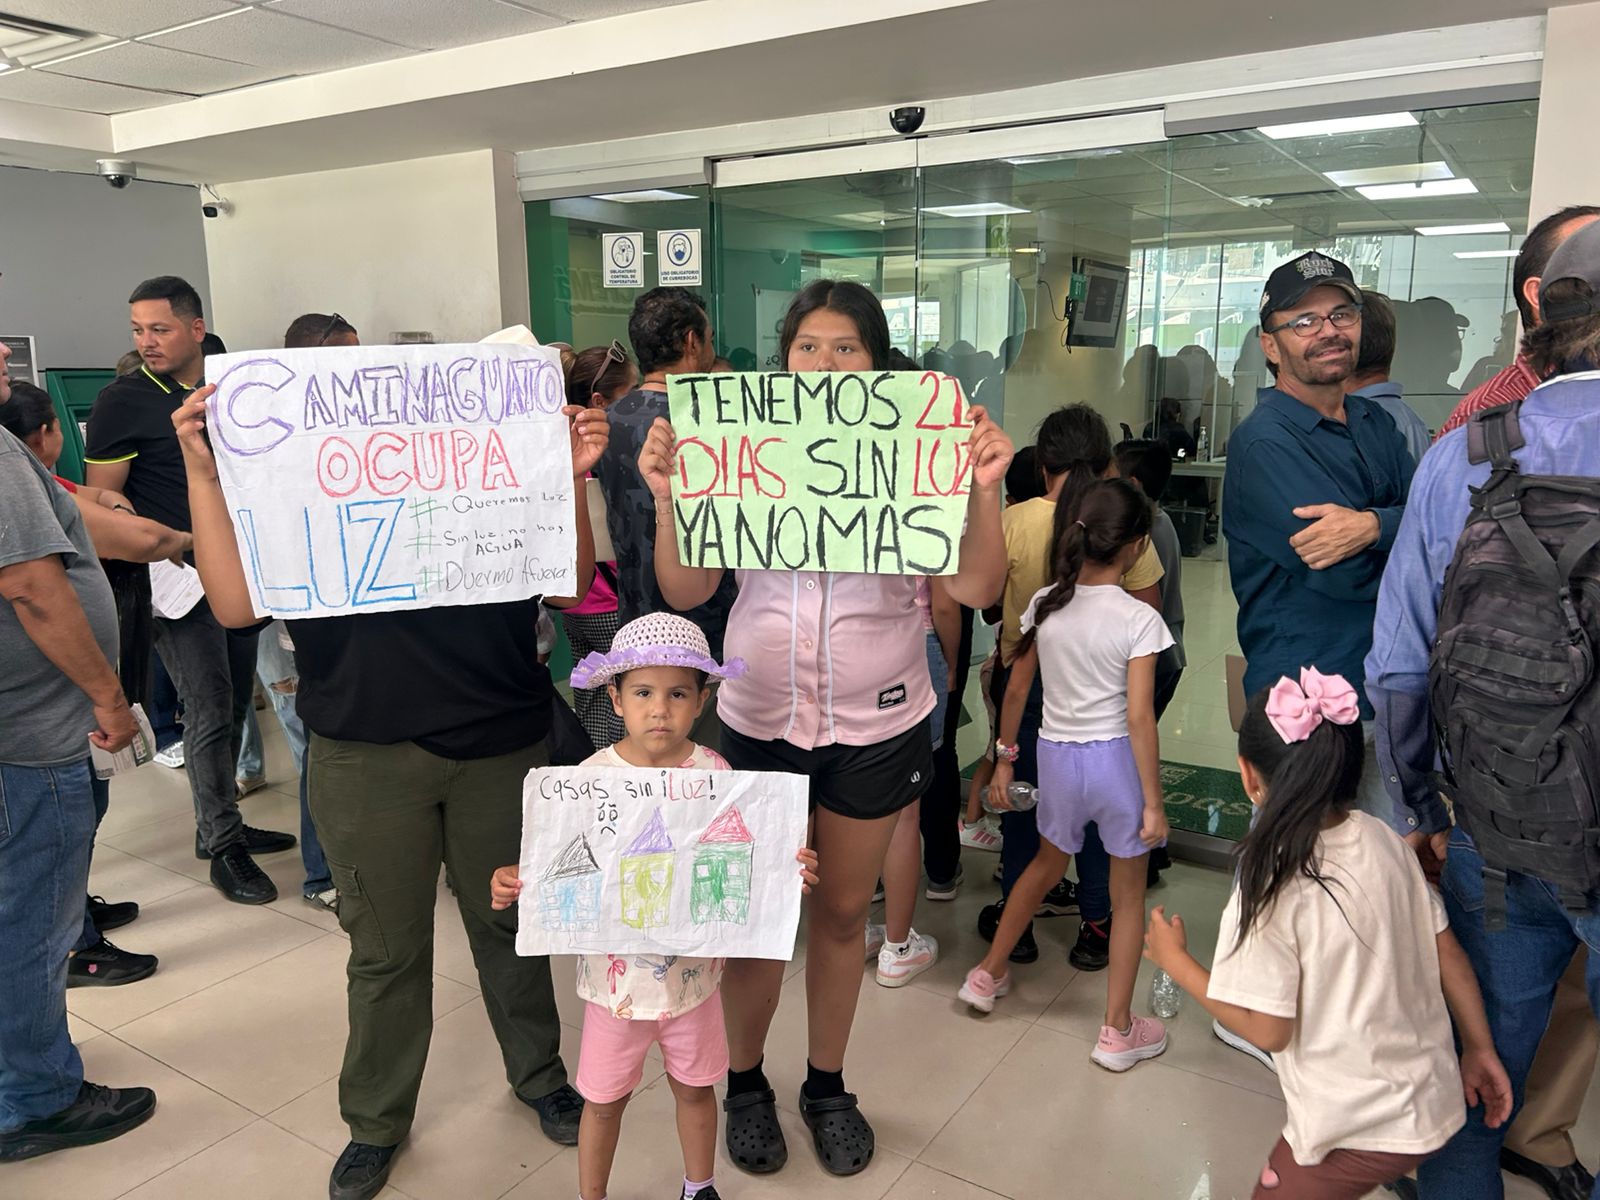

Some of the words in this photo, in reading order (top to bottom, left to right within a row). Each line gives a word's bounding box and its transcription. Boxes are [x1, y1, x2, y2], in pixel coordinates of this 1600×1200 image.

[675, 372, 902, 430] TENEMOS
[915, 371, 974, 430] 21
[316, 428, 521, 498] OCUPA
[673, 435, 788, 500] DIAS
[805, 438, 900, 500] SIN
[912, 436, 973, 497] LUZ
[237, 498, 417, 612] LUZ
[475, 538, 524, 556] AGUA
